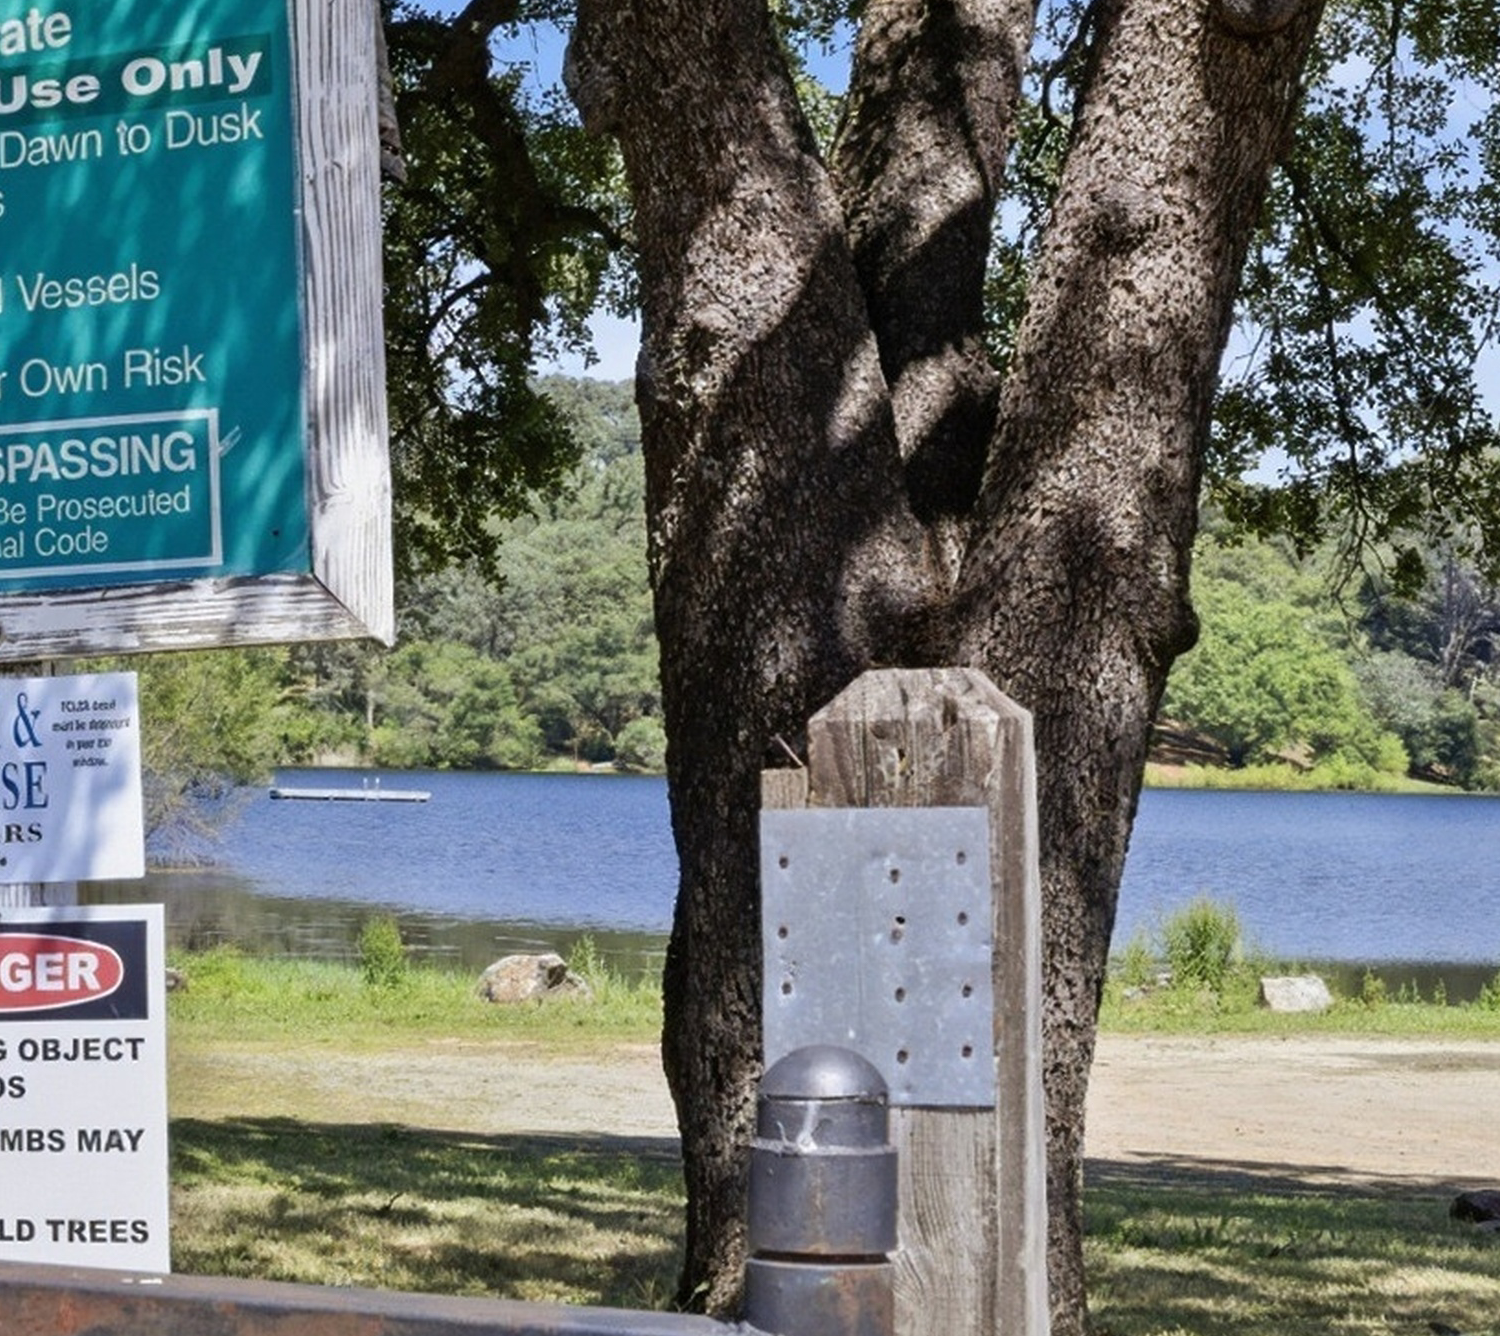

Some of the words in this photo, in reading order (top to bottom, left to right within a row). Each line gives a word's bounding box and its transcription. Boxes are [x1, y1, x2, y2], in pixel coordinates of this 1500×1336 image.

[121, 49, 263, 93] Only
[0, 128, 101, 169] Dawn
[116, 119, 151, 153] to
[167, 103, 263, 149] Dusk
[17, 263, 160, 311] Vessels
[20, 359, 107, 397] Own
[124, 345, 205, 387] Risk
[38, 486, 191, 521] Prosecuted
[35, 526, 108, 555] Code
[13, 692, 43, 749] &
[18, 1038, 145, 1062] OBJECT
[78, 1129, 145, 1153] MAY
[46, 1219, 149, 1244] TREES
